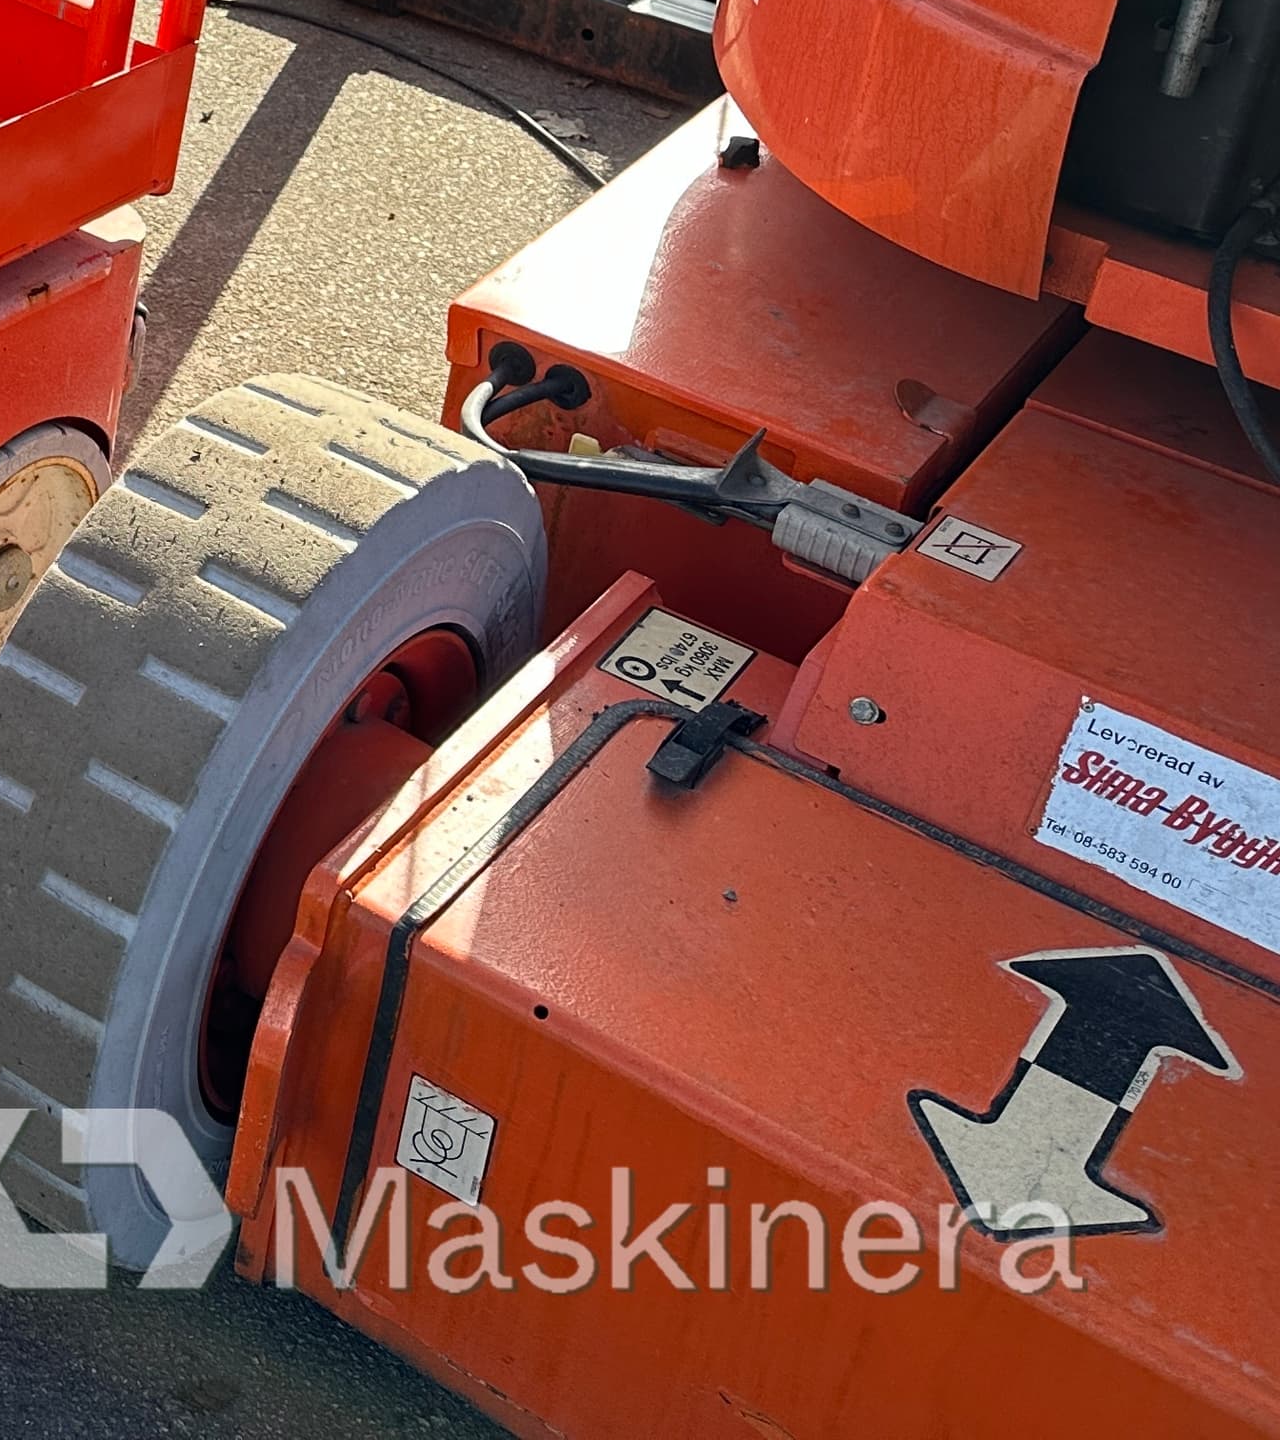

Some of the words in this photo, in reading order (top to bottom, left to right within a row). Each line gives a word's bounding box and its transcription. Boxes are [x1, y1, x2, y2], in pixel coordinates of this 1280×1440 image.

[704, 655, 734, 682] MAX
[1197, 769, 1225, 790] av
[1073, 830, 1127, 865] 08-583
[1128, 857, 1158, 880] 594
[1161, 871, 1182, 890] 00
